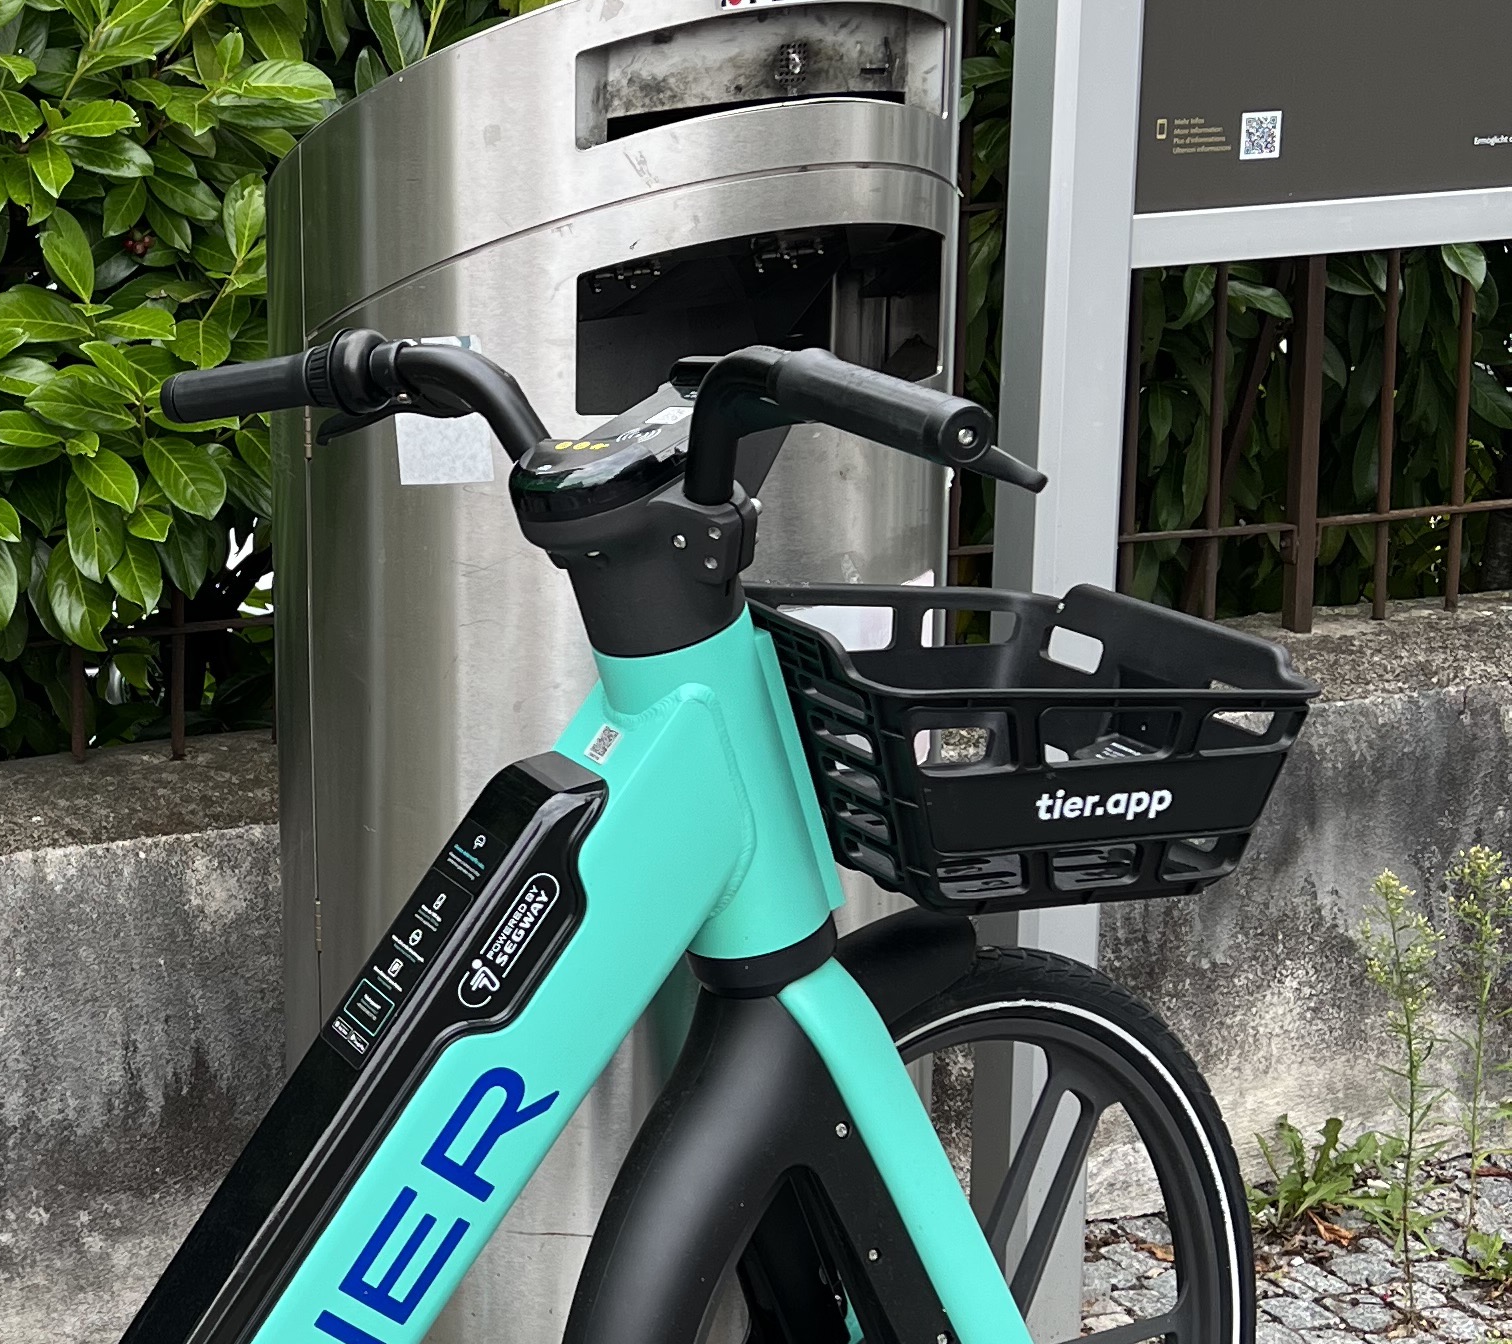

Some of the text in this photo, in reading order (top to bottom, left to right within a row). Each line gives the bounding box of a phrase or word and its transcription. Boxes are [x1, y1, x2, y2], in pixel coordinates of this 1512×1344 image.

[1035, 789, 1172, 820] tier.app
[486, 884, 539, 961] POWERED BY
[495, 889, 549, 967] SEGWAY
